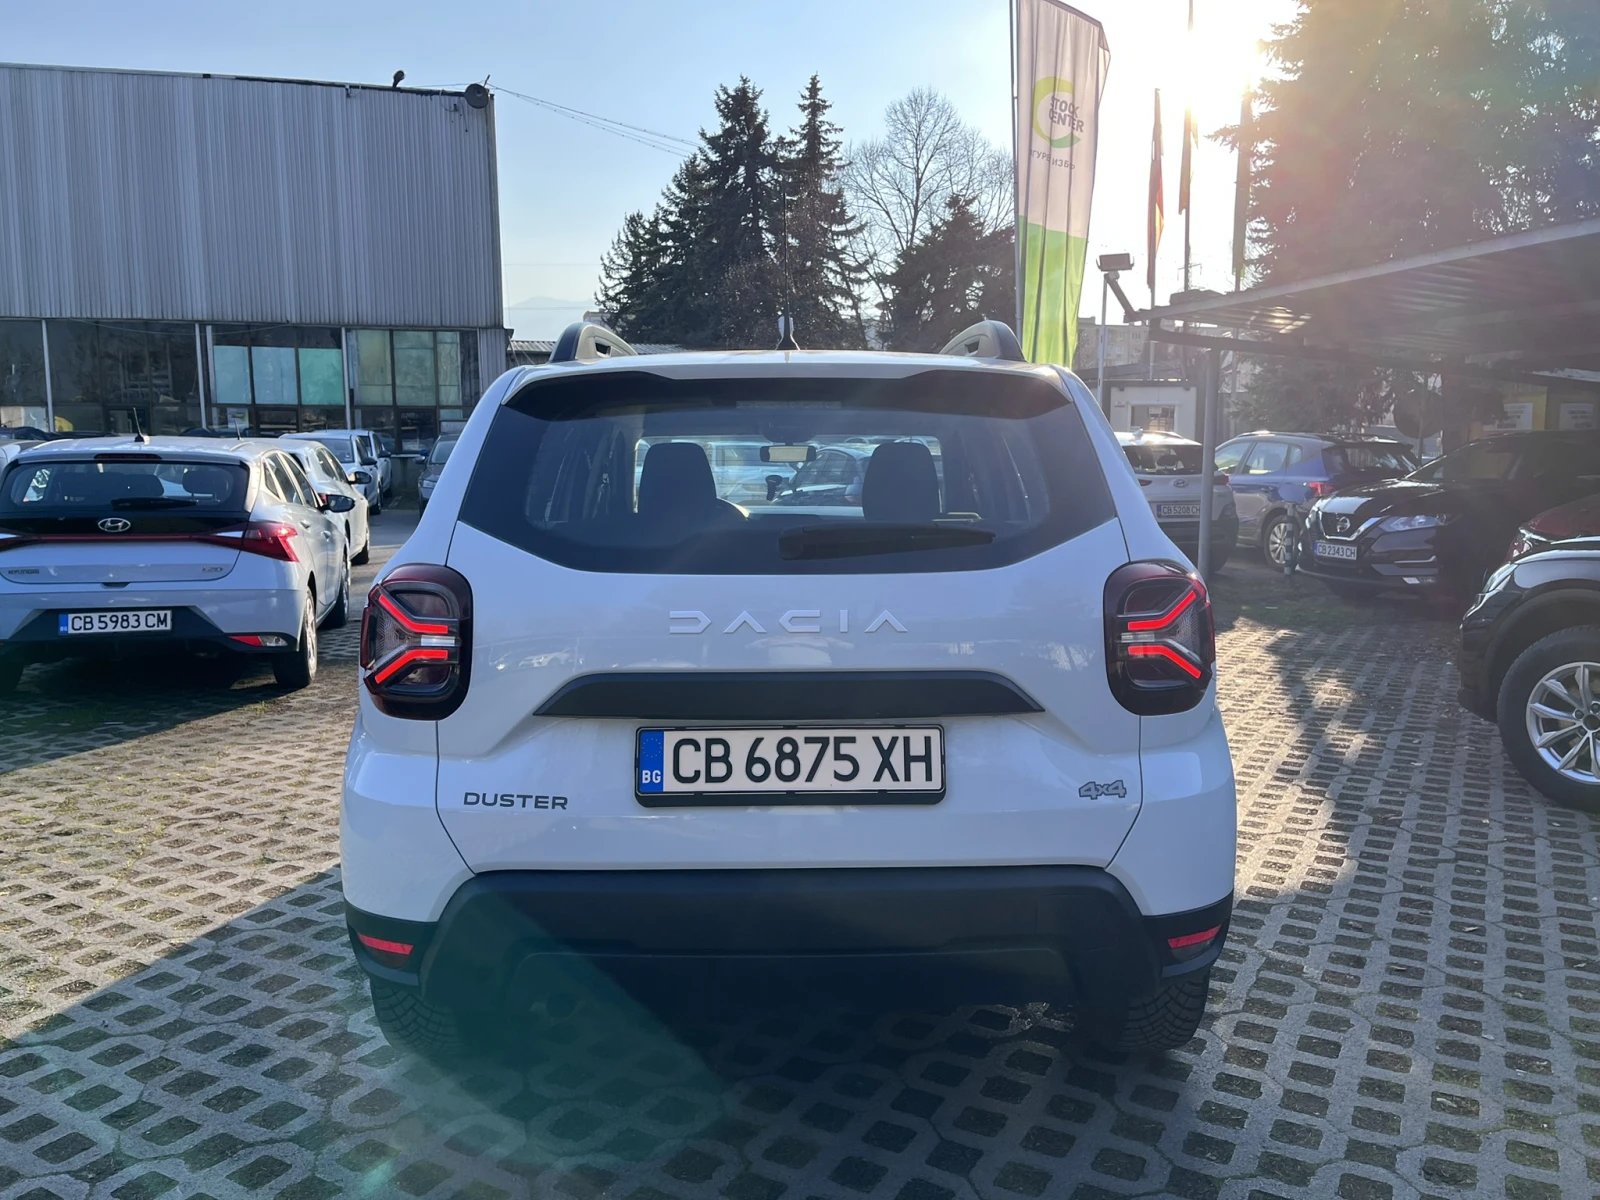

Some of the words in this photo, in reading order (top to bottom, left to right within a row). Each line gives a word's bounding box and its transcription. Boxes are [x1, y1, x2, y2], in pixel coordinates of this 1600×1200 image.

[1327, 545, 1344, 556] 2343
[1345, 548, 1355, 558] CH
[71, 615, 94, 631] CB
[98, 614, 141, 630] 5983
[145, 612, 168, 628] CM
[669, 609, 909, 634] DACIA
[672, 738, 733, 784] CB
[745, 736, 860, 783] 6875
[871, 735, 933, 783] XH
[642, 770, 661, 784] BG
[463, 792, 568, 810] DUSTER
